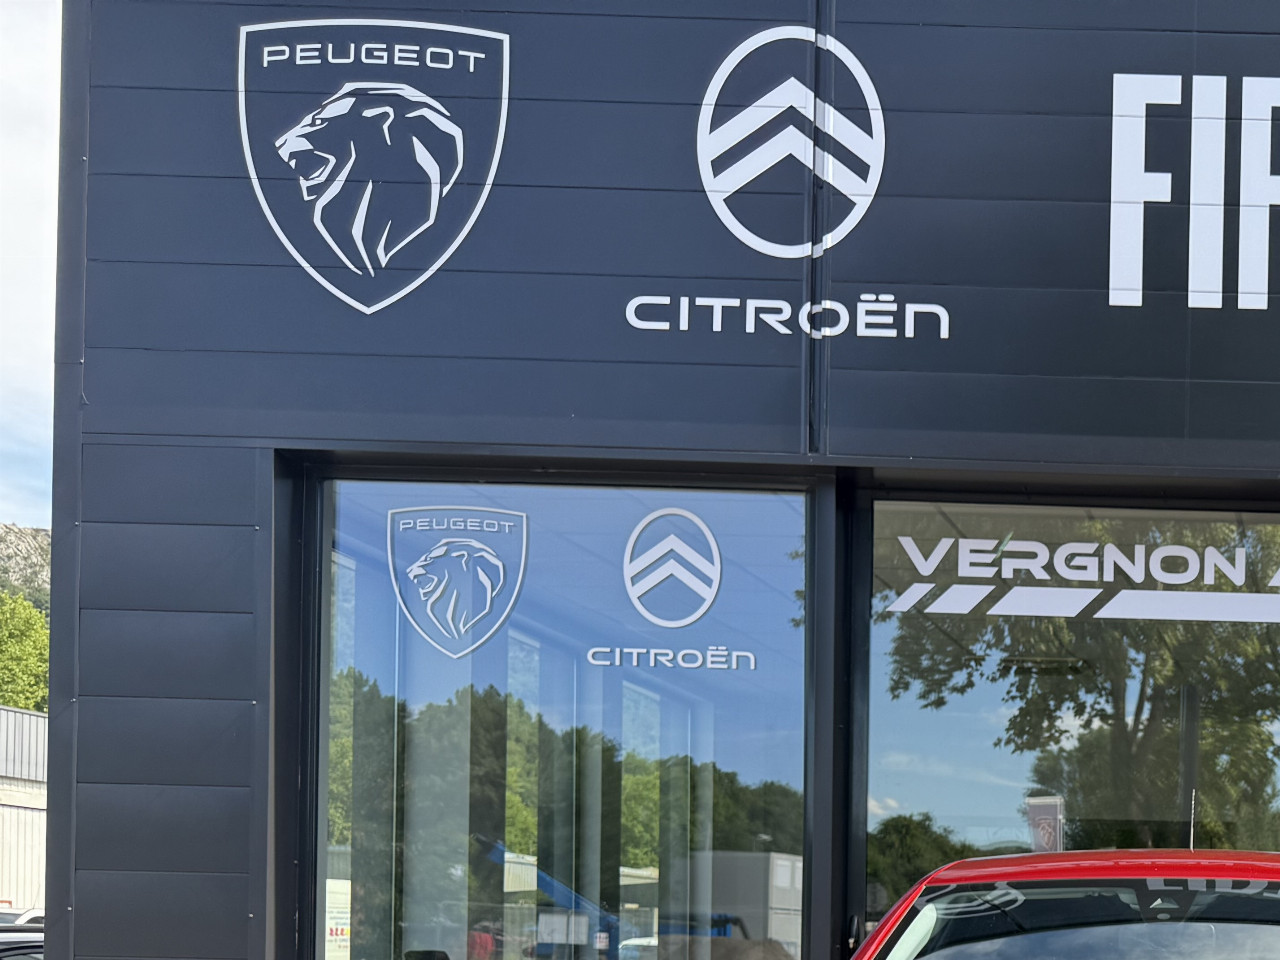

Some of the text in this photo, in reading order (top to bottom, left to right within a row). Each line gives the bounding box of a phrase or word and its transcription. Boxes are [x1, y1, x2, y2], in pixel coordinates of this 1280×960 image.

[262, 43, 486, 73] PEUGEOT
[625, 293, 950, 339] CITROËN
[399, 517, 514, 534] PEUGEOT
[897, 536, 1246, 586] VERGNON
[586, 645, 756, 670] CITROËN
